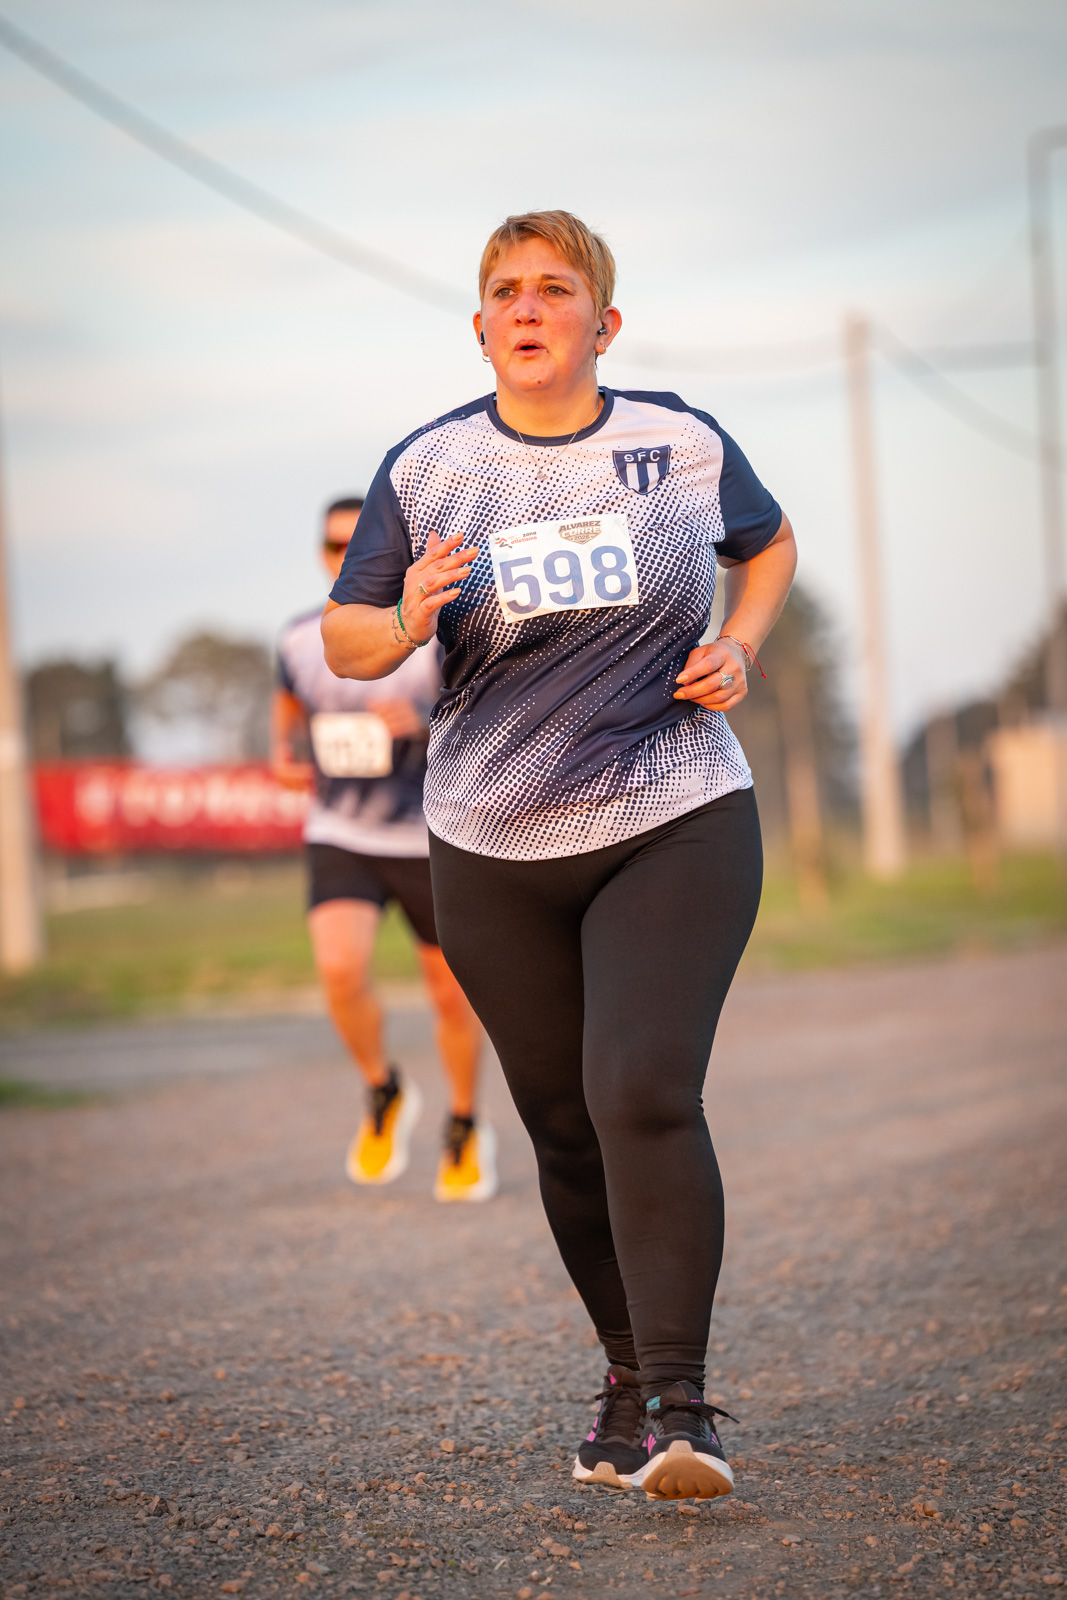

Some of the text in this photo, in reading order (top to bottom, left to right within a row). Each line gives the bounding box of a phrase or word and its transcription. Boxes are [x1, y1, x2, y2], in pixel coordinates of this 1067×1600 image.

[624, 450, 661, 463] SFC
[559, 520, 601, 533] ALVAREZ
[561, 527, 602, 538] CORRE
[510, 536, 538, 545] atletismo
[499, 545, 632, 614] 598
